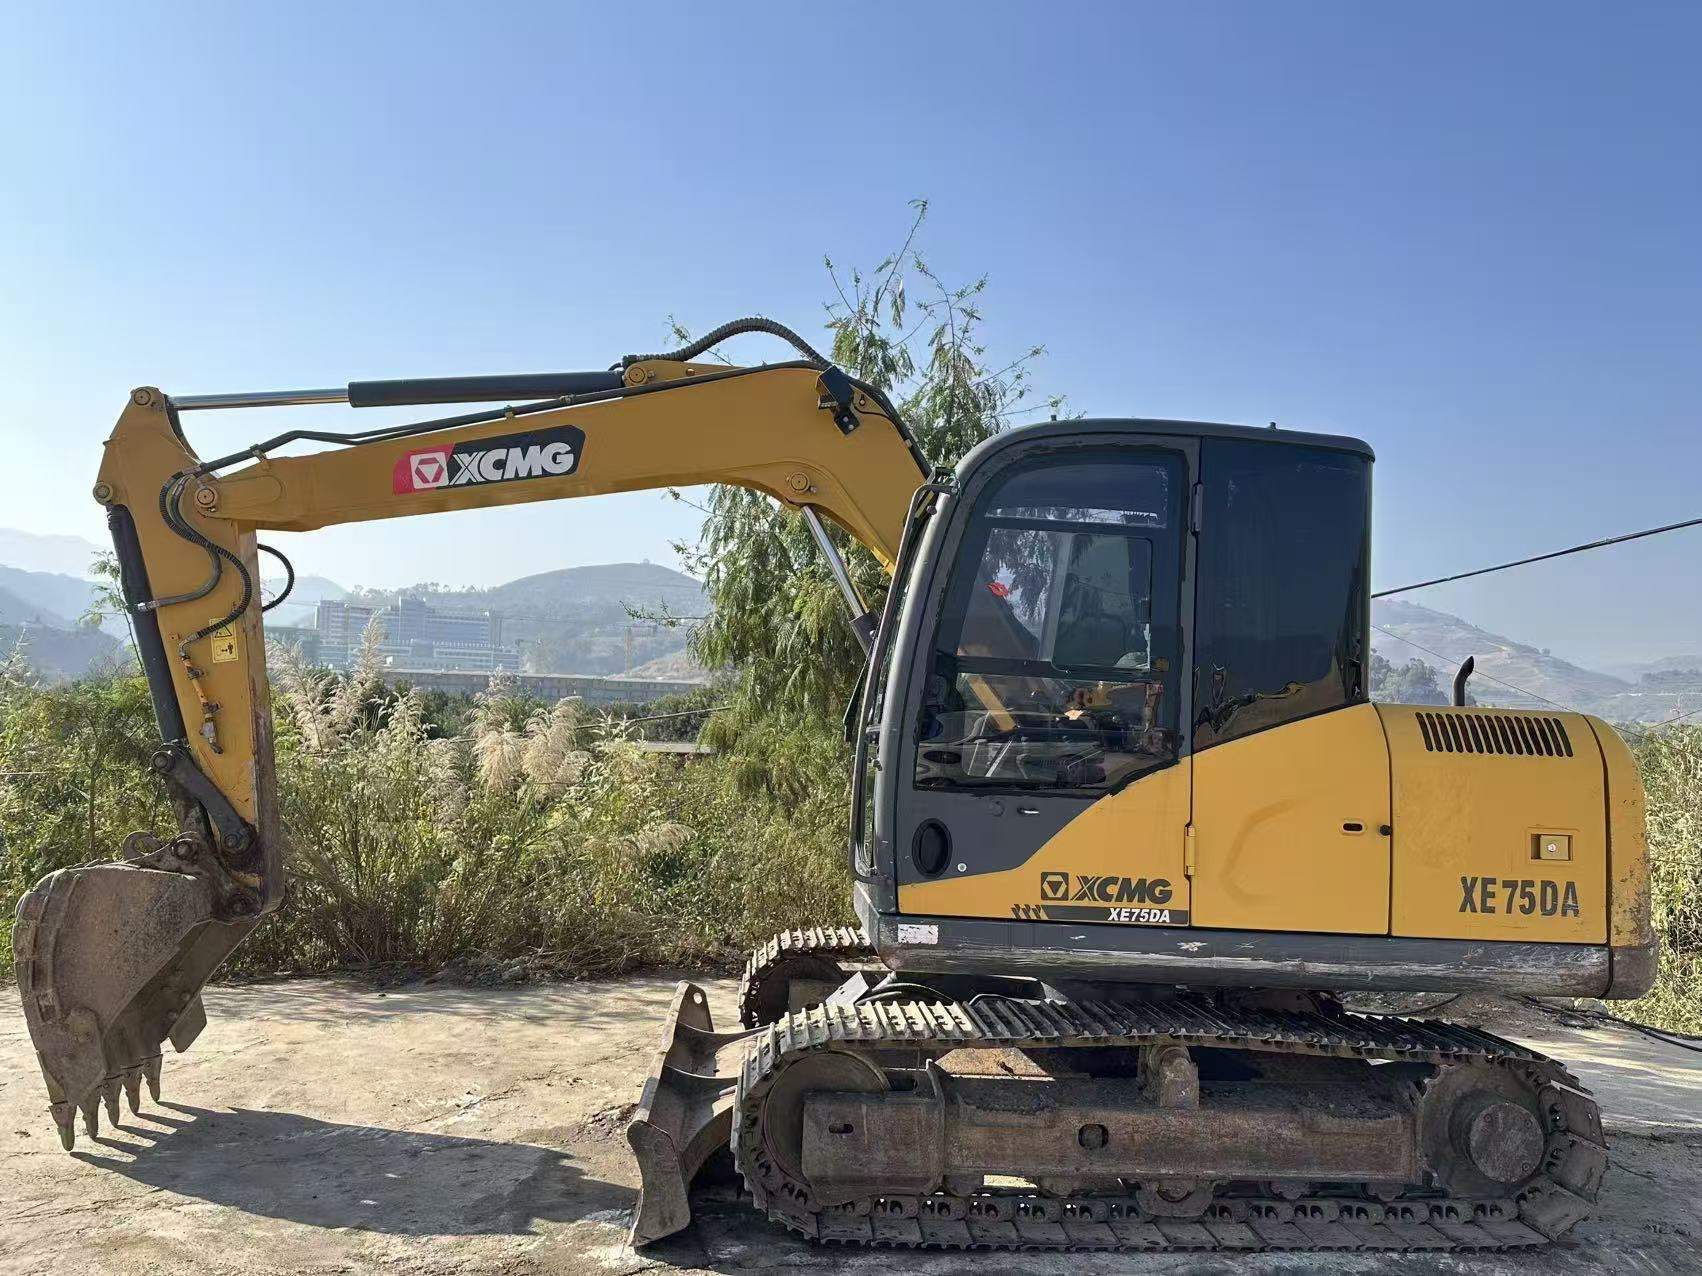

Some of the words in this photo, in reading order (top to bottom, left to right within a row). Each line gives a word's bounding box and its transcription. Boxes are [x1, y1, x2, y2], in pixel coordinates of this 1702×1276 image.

[450, 442, 573, 485] XCMG
[1071, 875, 1172, 904] XCMG
[1459, 876, 1580, 917] XE75DA
[1108, 908, 1170, 923] XE75DA
